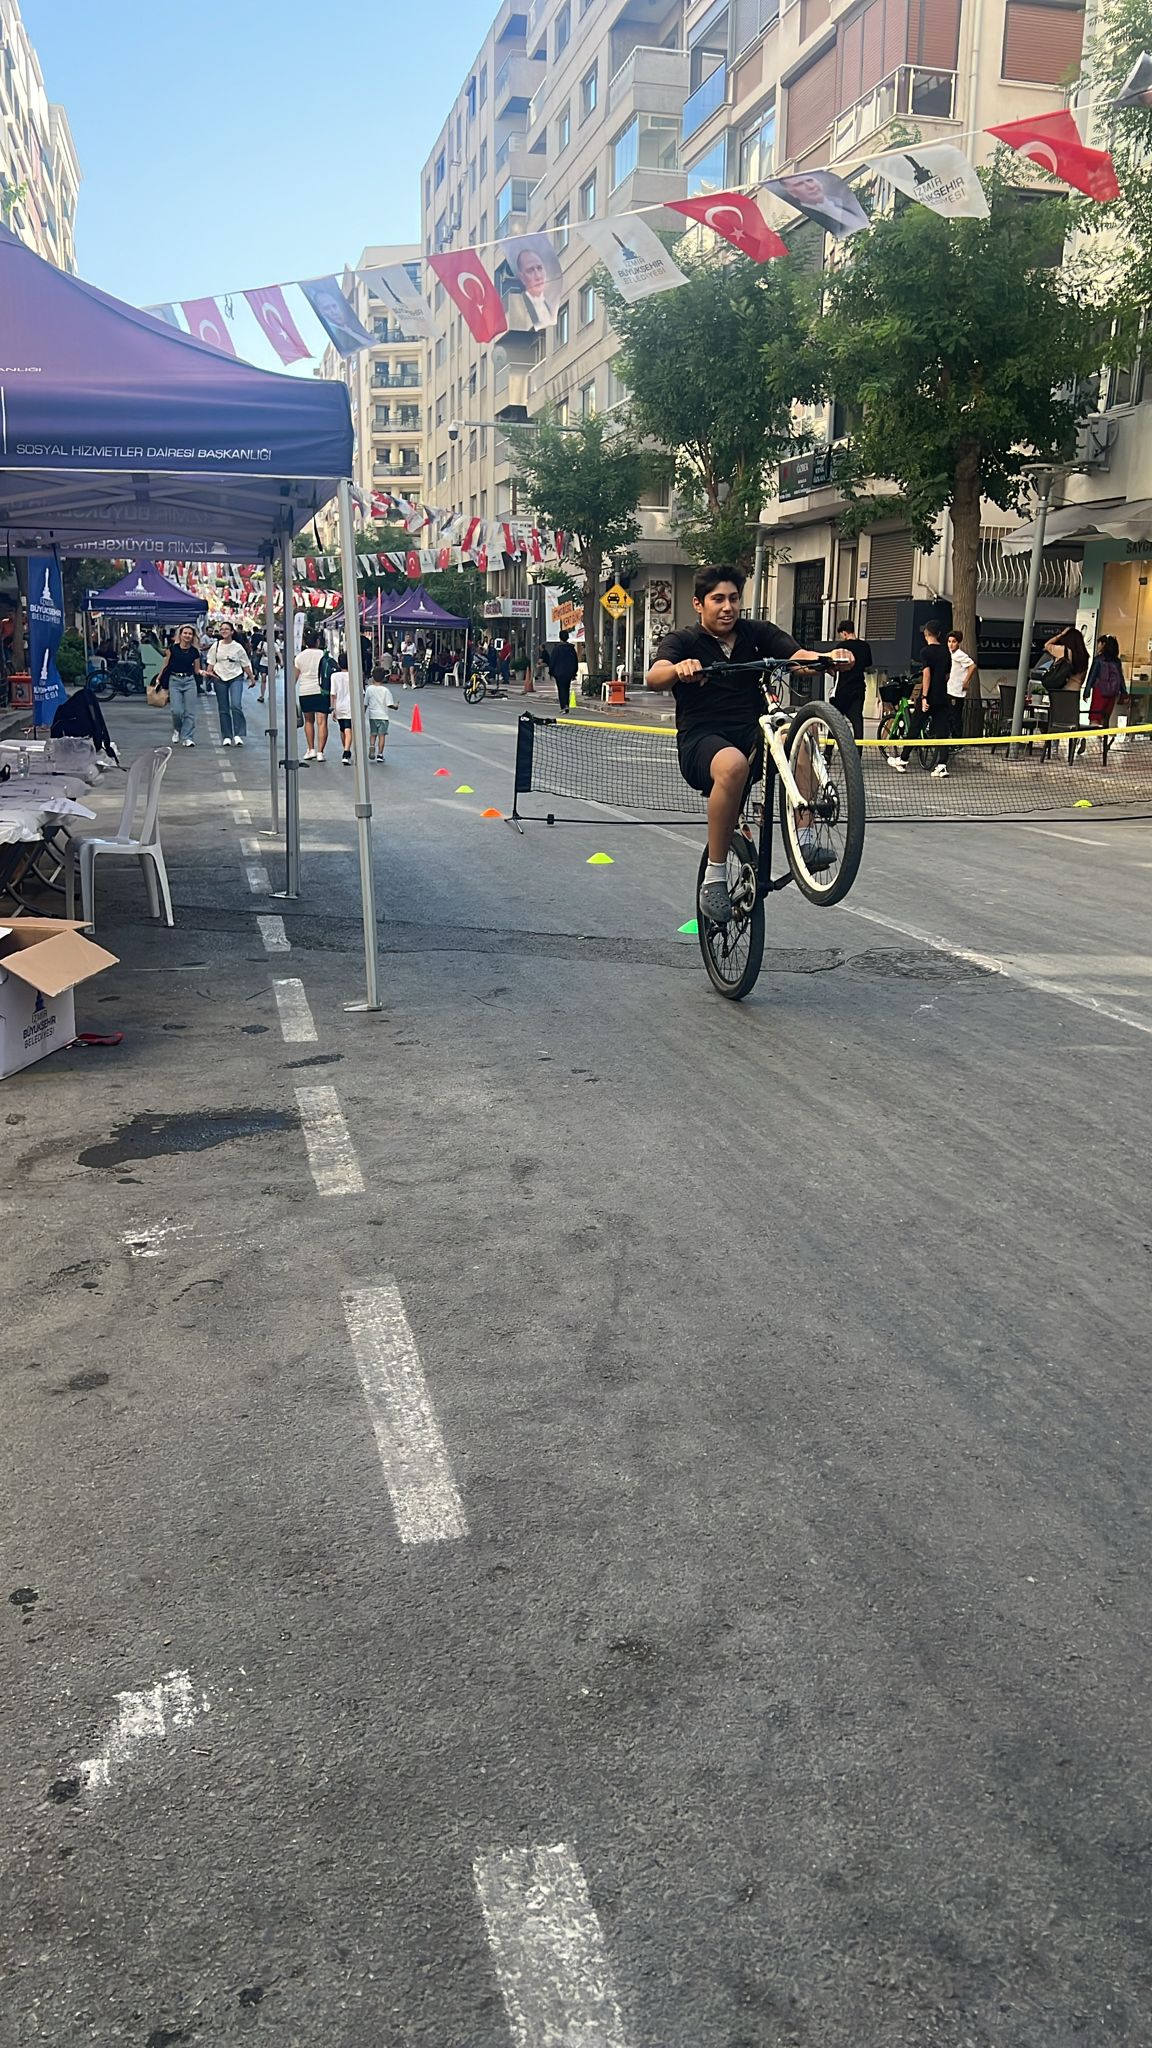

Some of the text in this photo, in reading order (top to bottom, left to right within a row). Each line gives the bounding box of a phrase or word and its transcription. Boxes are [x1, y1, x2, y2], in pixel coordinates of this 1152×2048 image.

[16, 444, 272, 461] SOSYAL HİZMETLER DAİRESİ BAŞKANLIĞI
